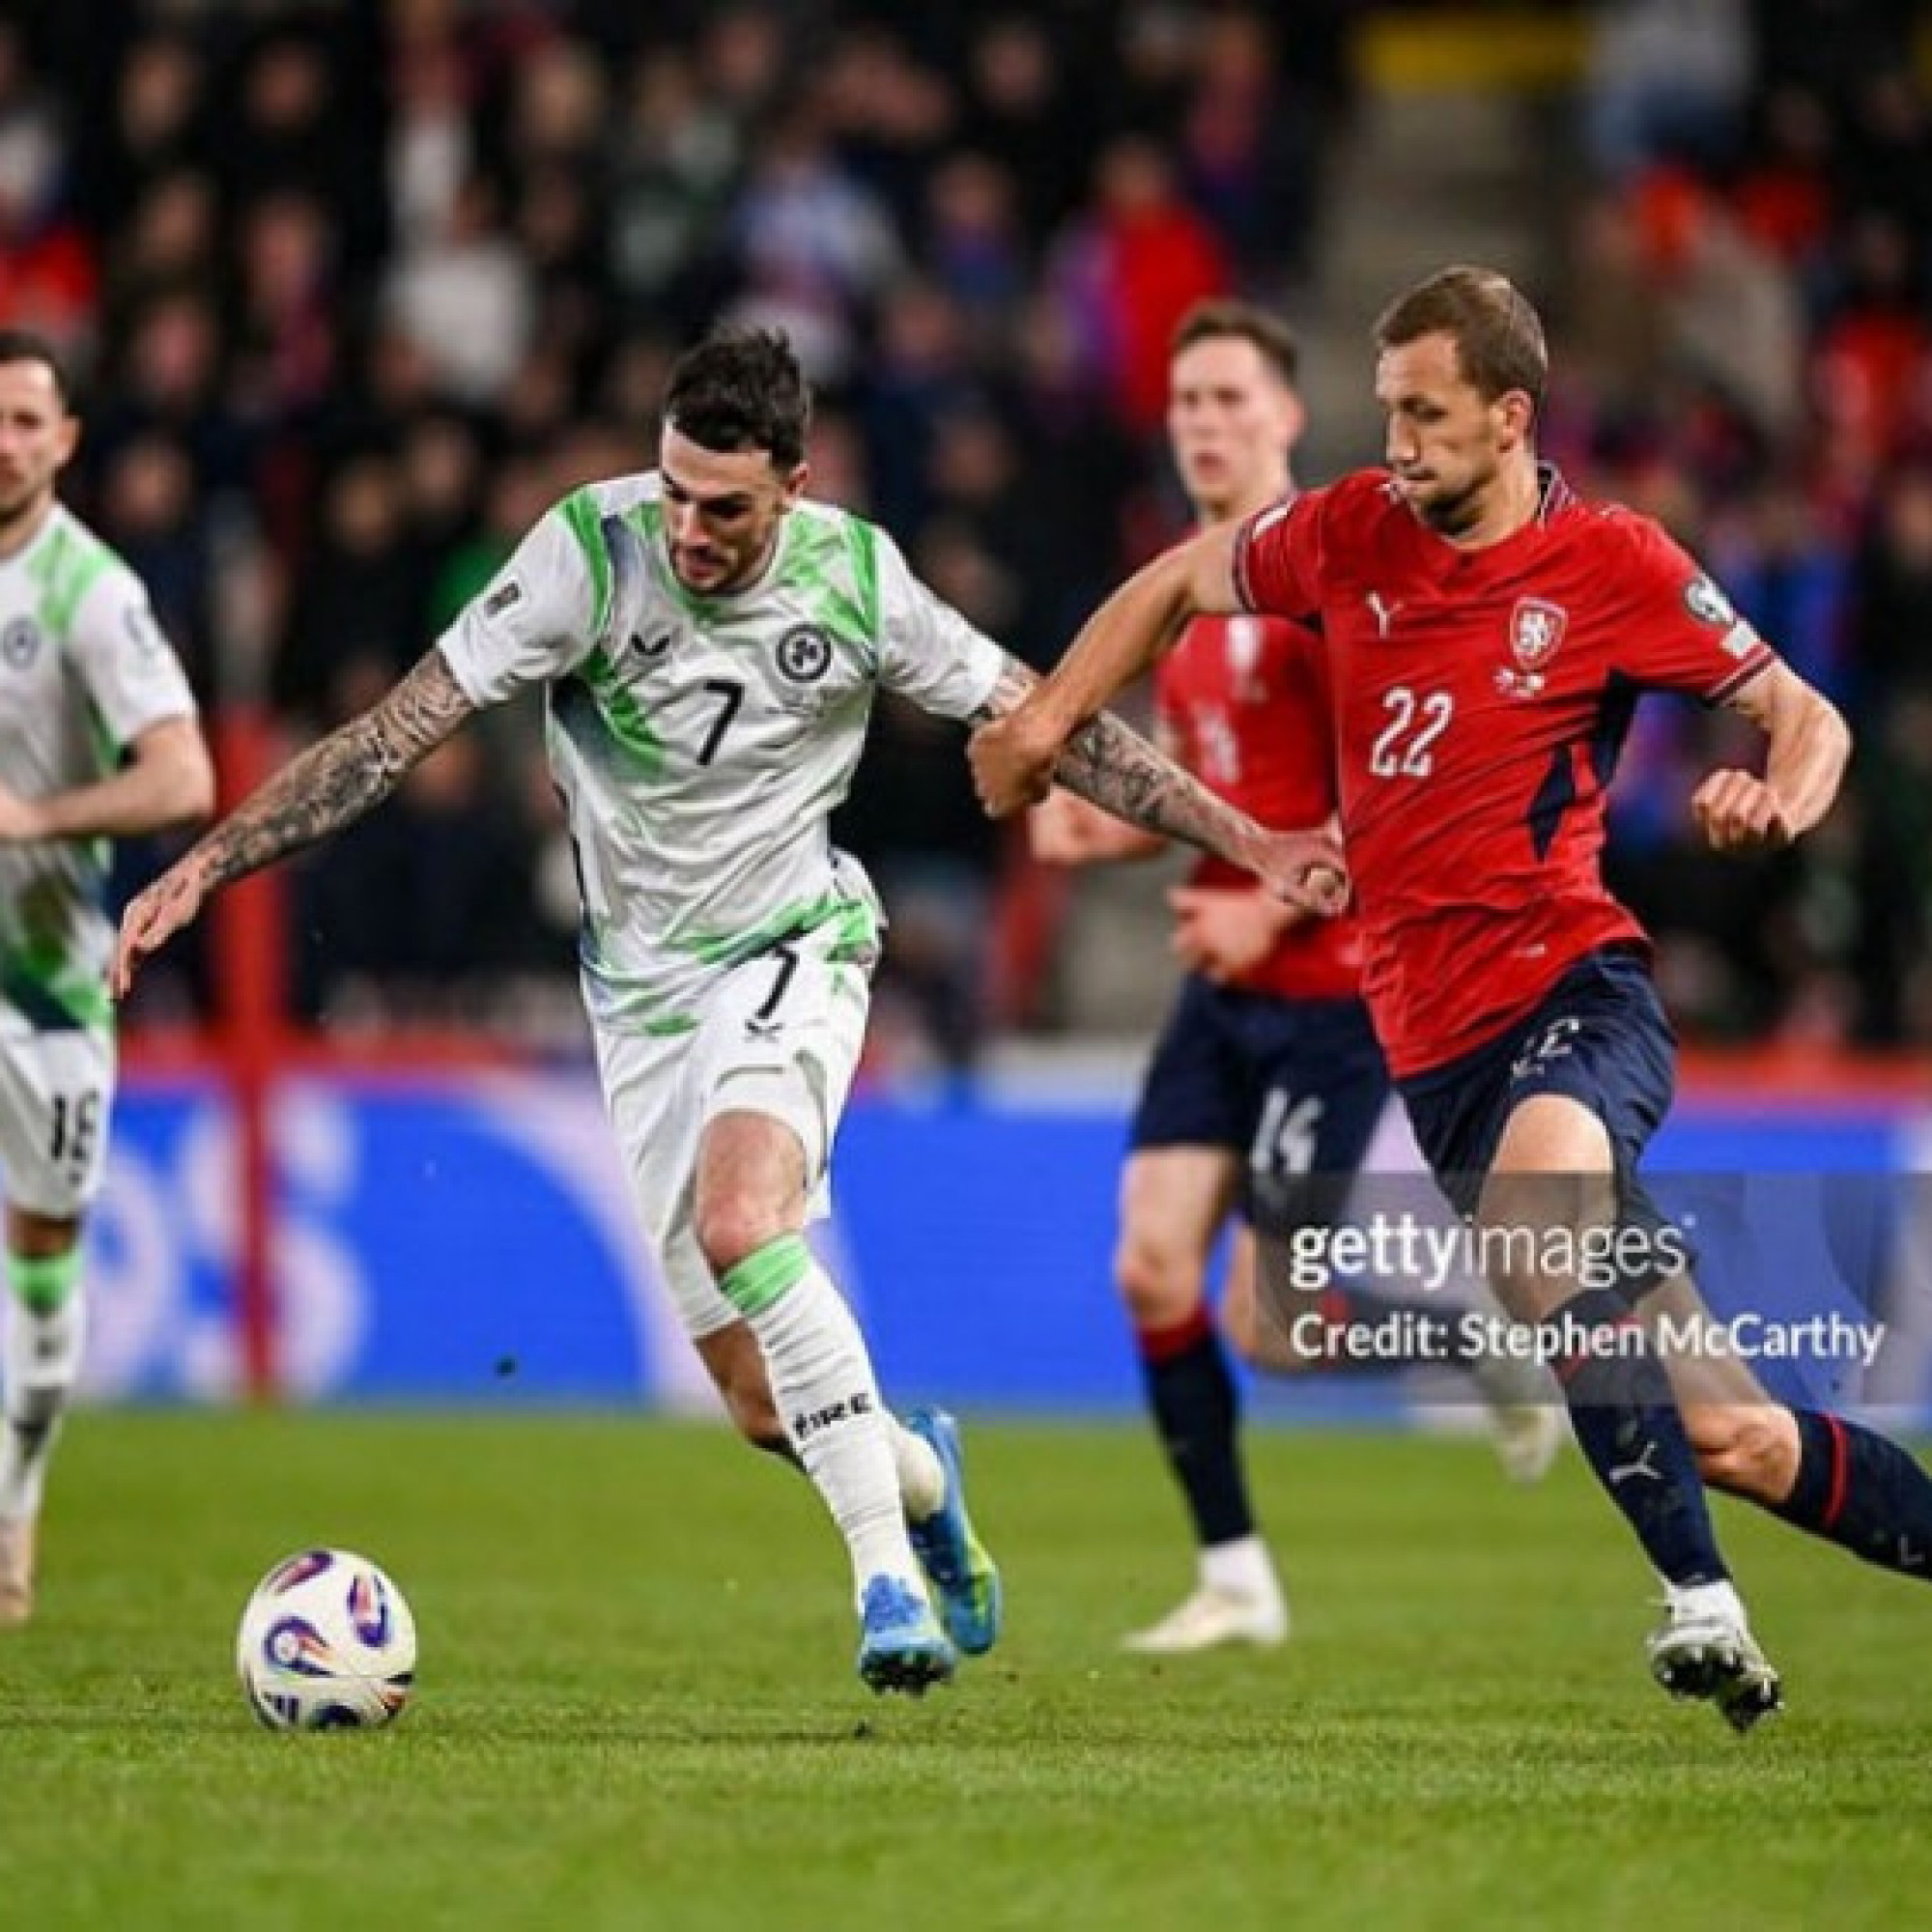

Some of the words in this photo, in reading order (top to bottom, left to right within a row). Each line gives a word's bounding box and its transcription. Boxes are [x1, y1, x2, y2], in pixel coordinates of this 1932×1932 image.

[696, 678, 745, 766] 7
[1369, 686, 1453, 778] 22
[754, 941, 800, 1020] 7
